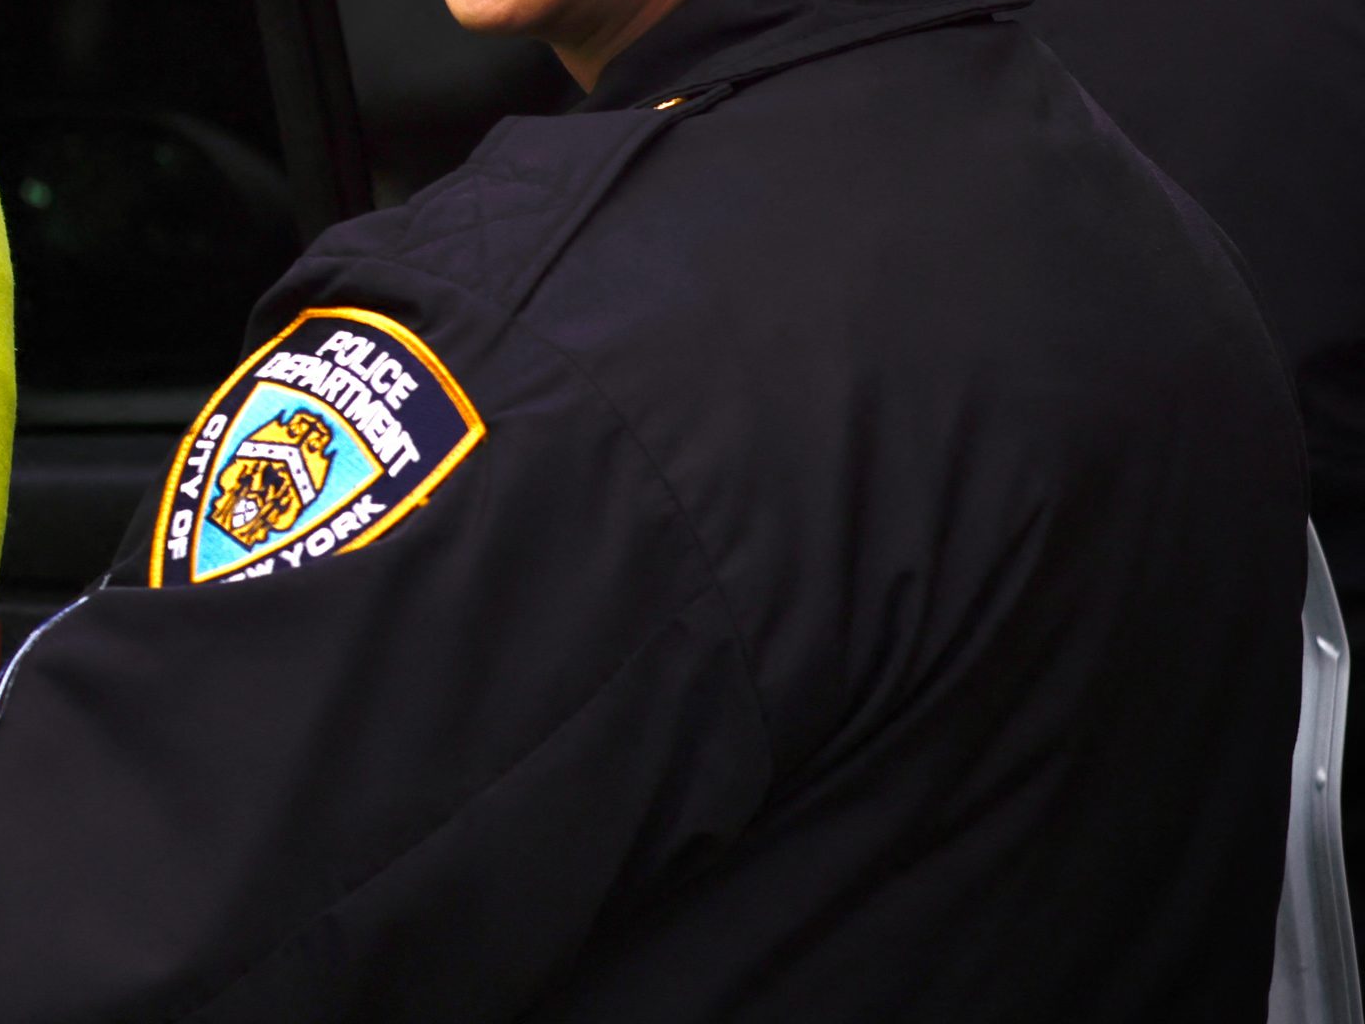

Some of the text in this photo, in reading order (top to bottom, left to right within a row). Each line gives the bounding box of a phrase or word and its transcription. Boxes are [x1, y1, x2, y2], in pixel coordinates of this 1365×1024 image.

[253, 351, 421, 478] DEPARTMENT
[315, 330, 420, 410] POLICE
[167, 413, 228, 560] CITY OF
[278, 493, 387, 568] YORK
